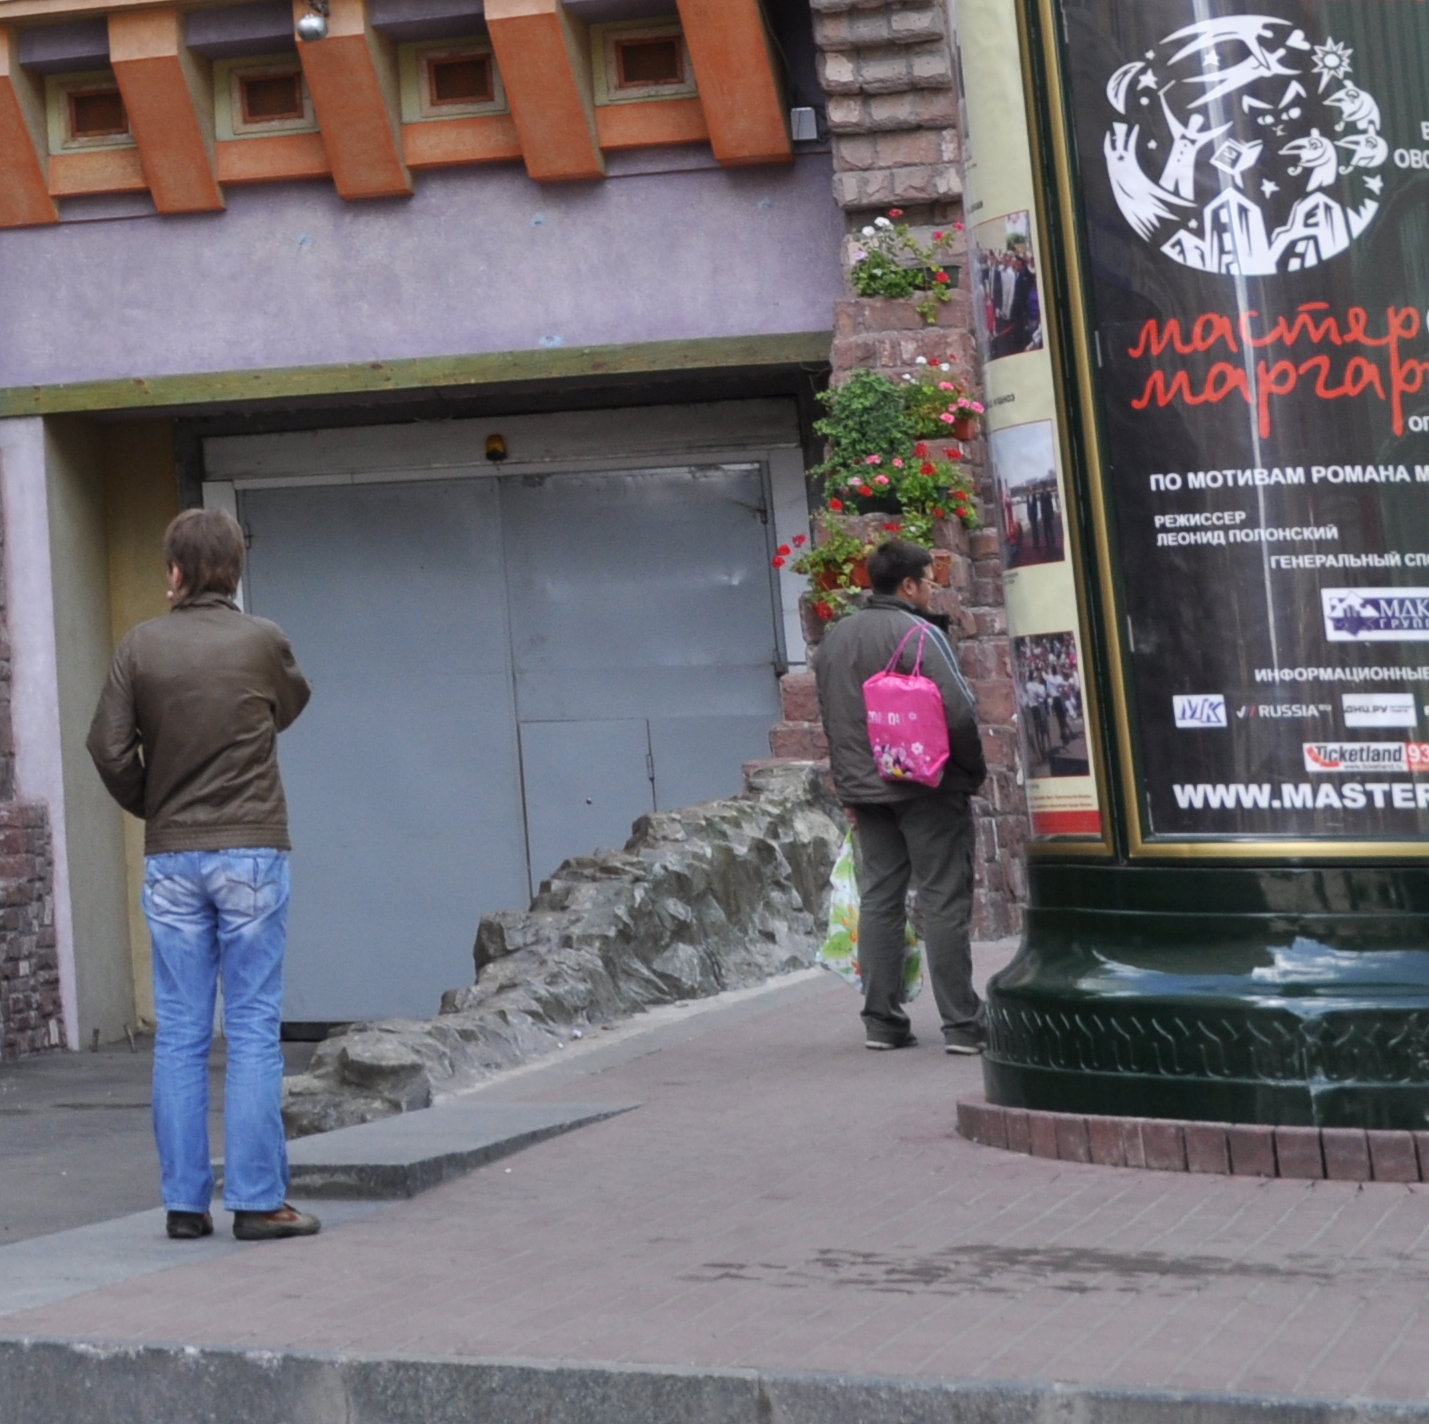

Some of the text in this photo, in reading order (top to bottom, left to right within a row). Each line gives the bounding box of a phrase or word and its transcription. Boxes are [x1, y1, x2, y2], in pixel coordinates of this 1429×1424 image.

[1130, 354, 1429, 440] маргар
[1150, 472, 1182, 491] ПО
[1187, 466, 1305, 488] МОТИВАМ
[1311, 464, 1411, 484] РОМАНА
[1154, 511, 1246, 528] РЕЖИССЕР
[1156, 524, 1339, 547] ЛЕОНИД ПОЛОНСКИЙ
[1270, 551, 1429, 569] ГЕНЕРАЛЬНЫЙ СП
